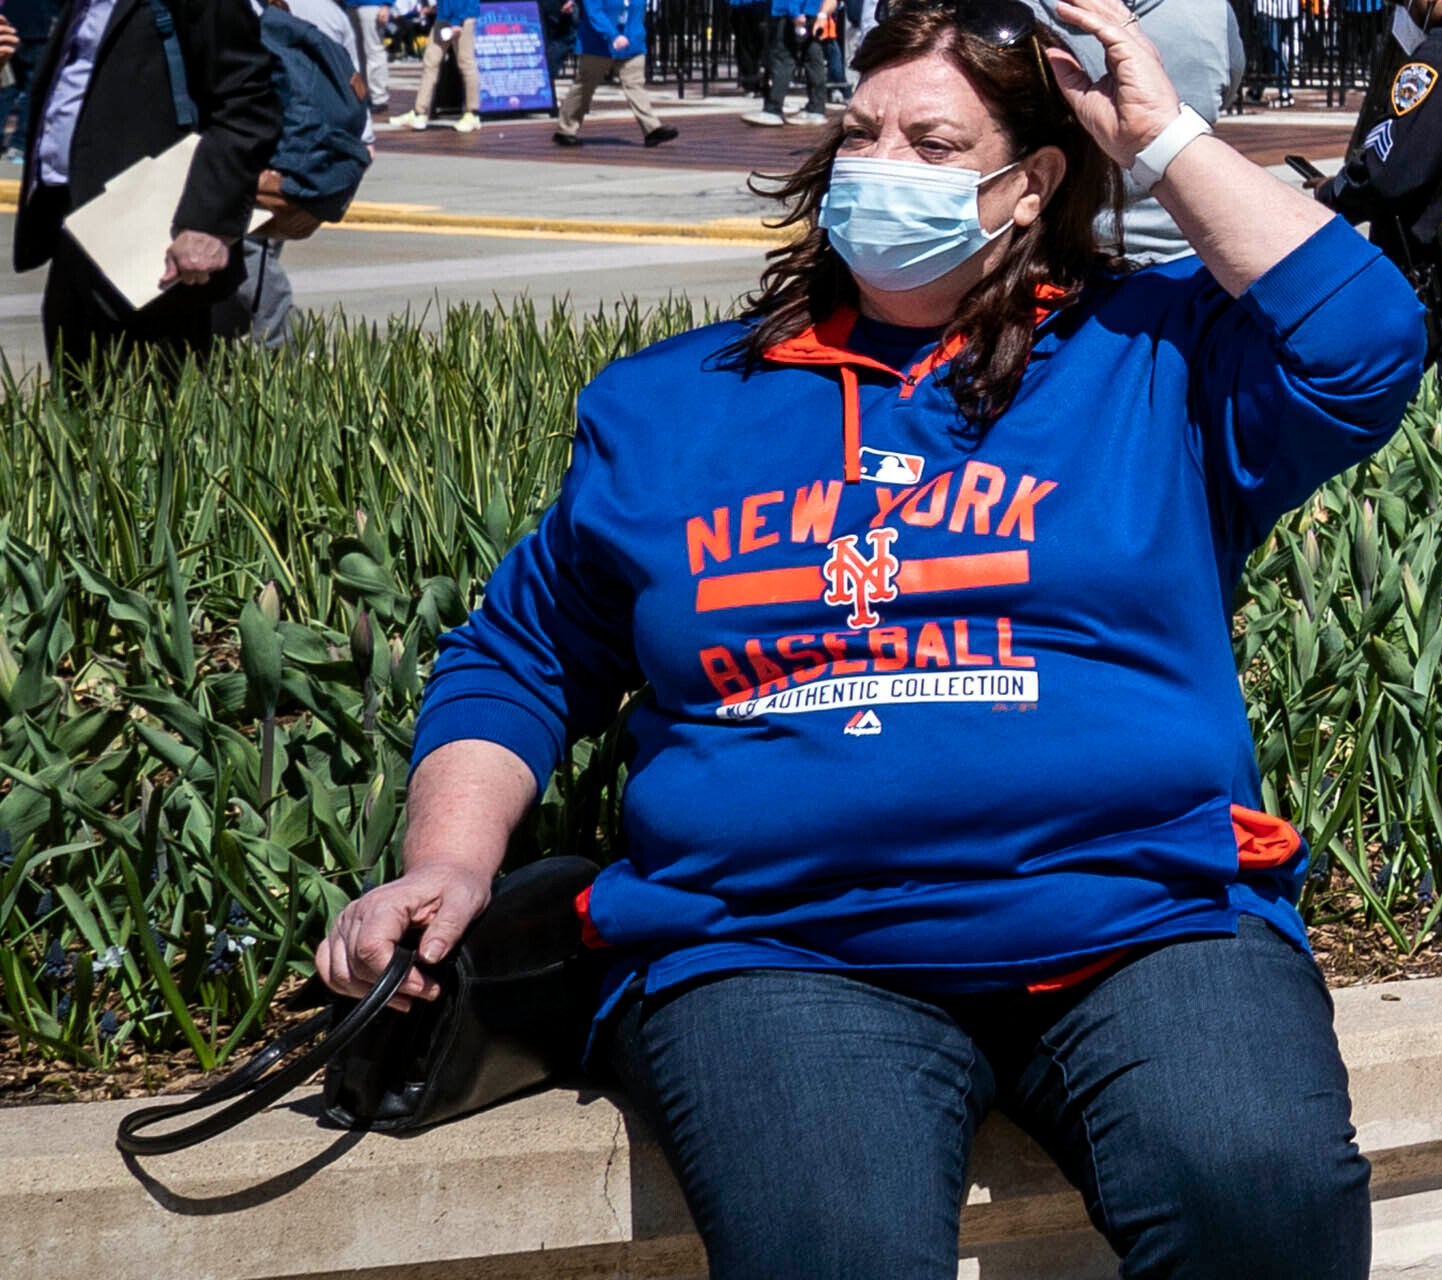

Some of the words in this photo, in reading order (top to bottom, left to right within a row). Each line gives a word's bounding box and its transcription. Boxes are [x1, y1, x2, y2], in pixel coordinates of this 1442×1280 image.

[686, 480, 842, 575] NEW
[869, 461, 1059, 542] YORK
[700, 618, 1036, 707] BASEBALL
[766, 680, 879, 710] AUTHENTIC
[890, 675, 1025, 698] COLLECTION
